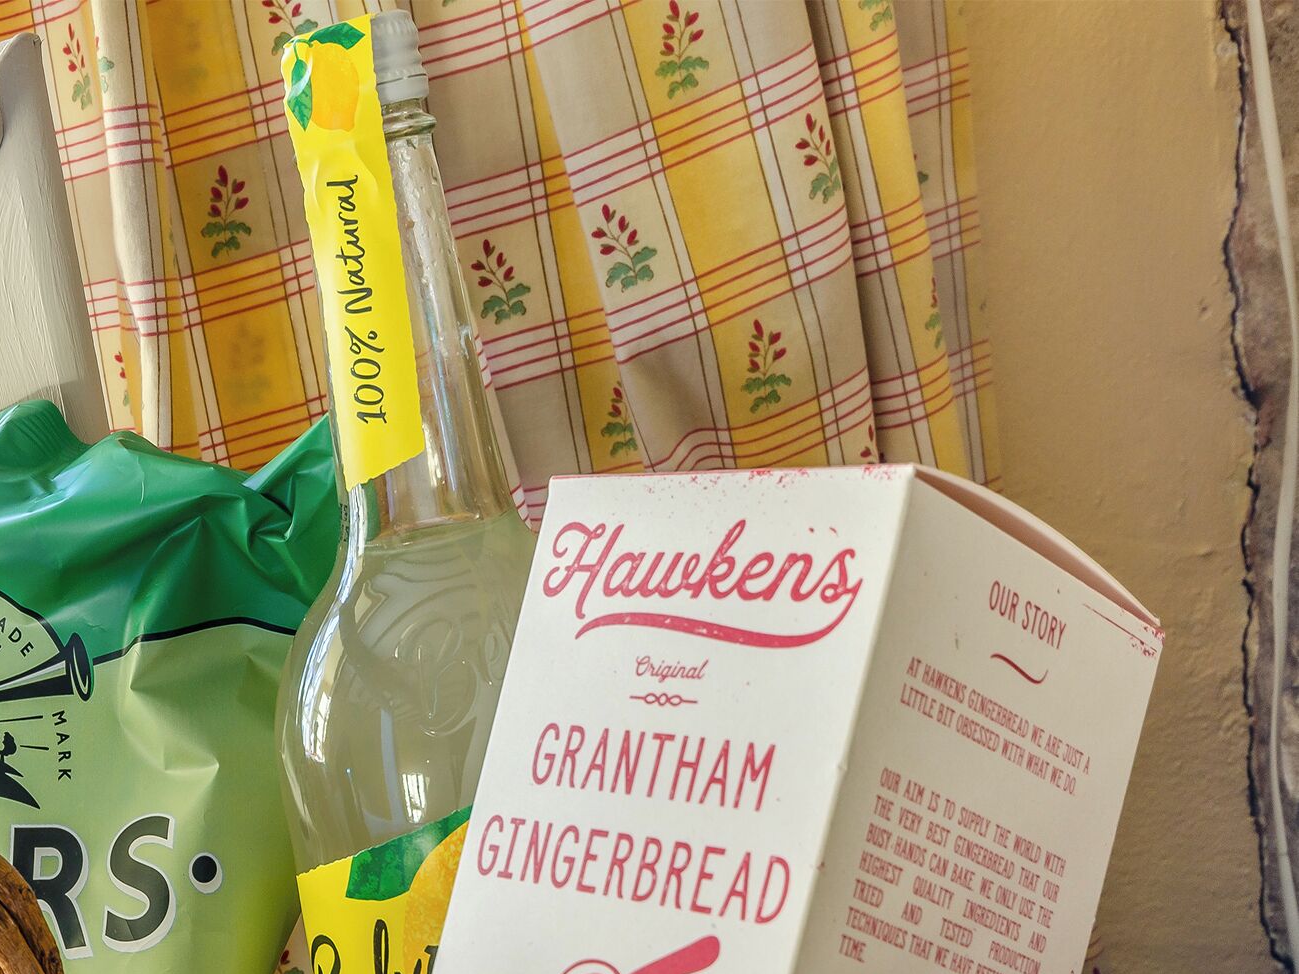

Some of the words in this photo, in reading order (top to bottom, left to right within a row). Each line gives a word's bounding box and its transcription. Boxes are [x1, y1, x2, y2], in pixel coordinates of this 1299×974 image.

[327, 174, 373, 312] Natural
[345, 325, 387, 425] 100%
[988, 580, 1019, 624] OUR
[1022, 600, 1067, 649] STORY
[635, 655, 709, 683] Original
[906, 656, 922, 678] AT
[922, 664, 967, 703] HAWKENS
[967, 689, 1029, 738] GINGERBREAD
[1030, 724, 1045, 748] WE
[1044, 733, 1063, 758] ARE
[1062, 743, 1084, 769] JUST
[1082, 755, 1090, 775] A
[52, 710, 72, 781] MARK
[531, 722, 776, 812] GRANTHAM
[900, 683, 936, 719] LITTLE
[936, 703, 956, 728] BIT
[955, 714, 1000, 752] OBSESSED
[1001, 739, 1025, 767] WITH
[1025, 752, 1050, 780] WHAT
[1049, 766, 1064, 788] WE
[477, 814, 792, 926] GINGERBREAD
[873, 794, 894, 821] THE
[898, 807, 923, 833] VERY
[925, 820, 951, 847] BEST
[953, 835, 1015, 879] GINGERBREAD
[1018, 866, 1040, 892] THAT
[1042, 879, 1060, 903] OUR
[879, 767, 901, 793] OUR
[903, 779, 925, 805] AIM
[927, 790, 941, 813] IS
[942, 798, 956, 820] TO
[957, 806, 991, 837] SUPPLY
[993, 823, 1011, 849] THE
[1012, 834, 1041, 864] WORLD
[1043, 850, 1066, 877] WITH
[852, 878, 884, 908] TRIED
[900, 901, 923, 925] AND
[939, 917, 975, 948] TESTED
[858, 850, 903, 886] HIGHEST
[912, 875, 954, 909] QUALITY
[962, 899, 1021, 941] INGREDIENTS
[1027, 931, 1047, 953] AND
[865, 822, 892, 850] BUSY
[893, 836, 927, 867] HANDS
[928, 852, 949, 877] CAN
[979, 876, 994, 899] WE
[995, 885, 1018, 910] ONLY
[1018, 896, 1036, 920] USE
[1036, 905, 1054, 929] THE
[846, 906, 908, 949] TECHNIQUES
[908, 933, 934, 960] THAT
[934, 945, 949, 968] WE
